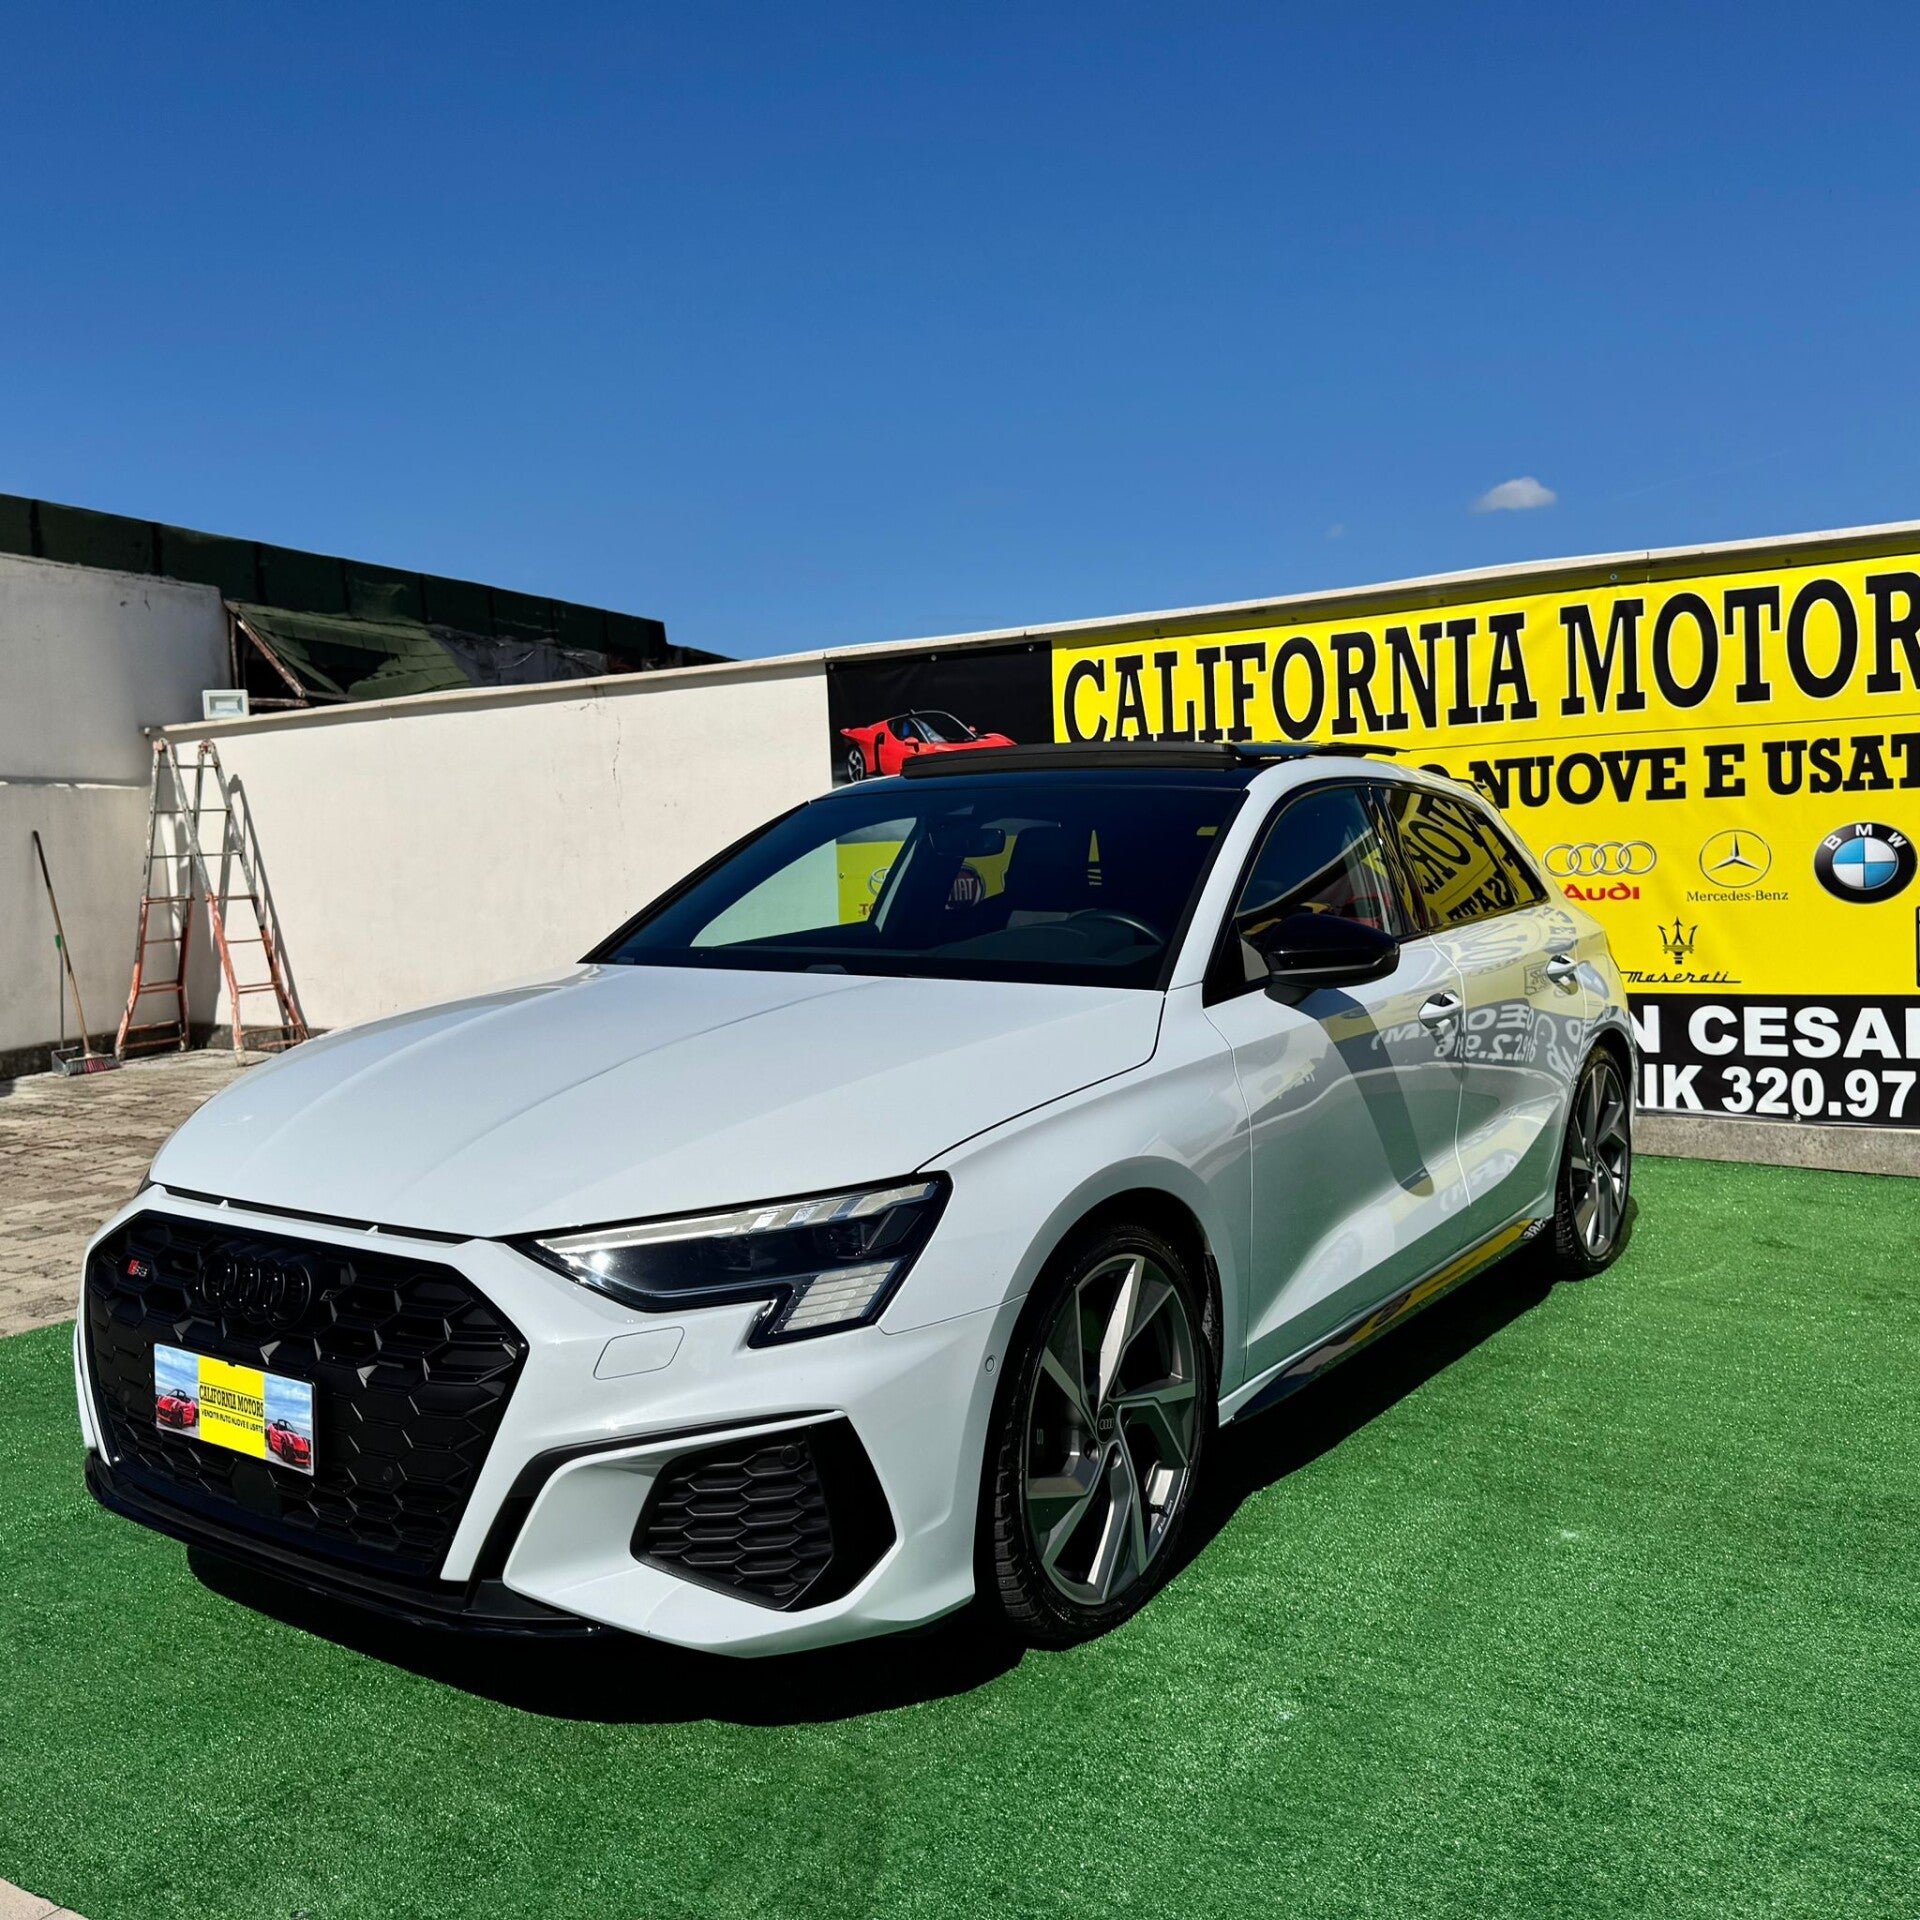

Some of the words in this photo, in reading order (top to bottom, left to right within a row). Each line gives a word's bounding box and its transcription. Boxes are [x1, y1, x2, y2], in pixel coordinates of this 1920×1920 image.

[1064, 614, 1538, 742] CALIFORNIA
[1560, 572, 1920, 717] MOTOR
[1468, 747, 1686, 809] NUOVE
[1704, 743, 1747, 799] E
[1823, 822, 1907, 850] BMW
[949, 877, 975, 901] IAT
[1686, 889, 1789, 903] Mercedes-Benz
[1636, 1063, 1705, 1111] IK
[1721, 1065, 1917, 1119] 320.97
[199, 1385, 236, 1409] CALIFORNIA
[237, 1395, 263, 1417] MOTORS
[231, 1416, 246, 1428] NUOVE
